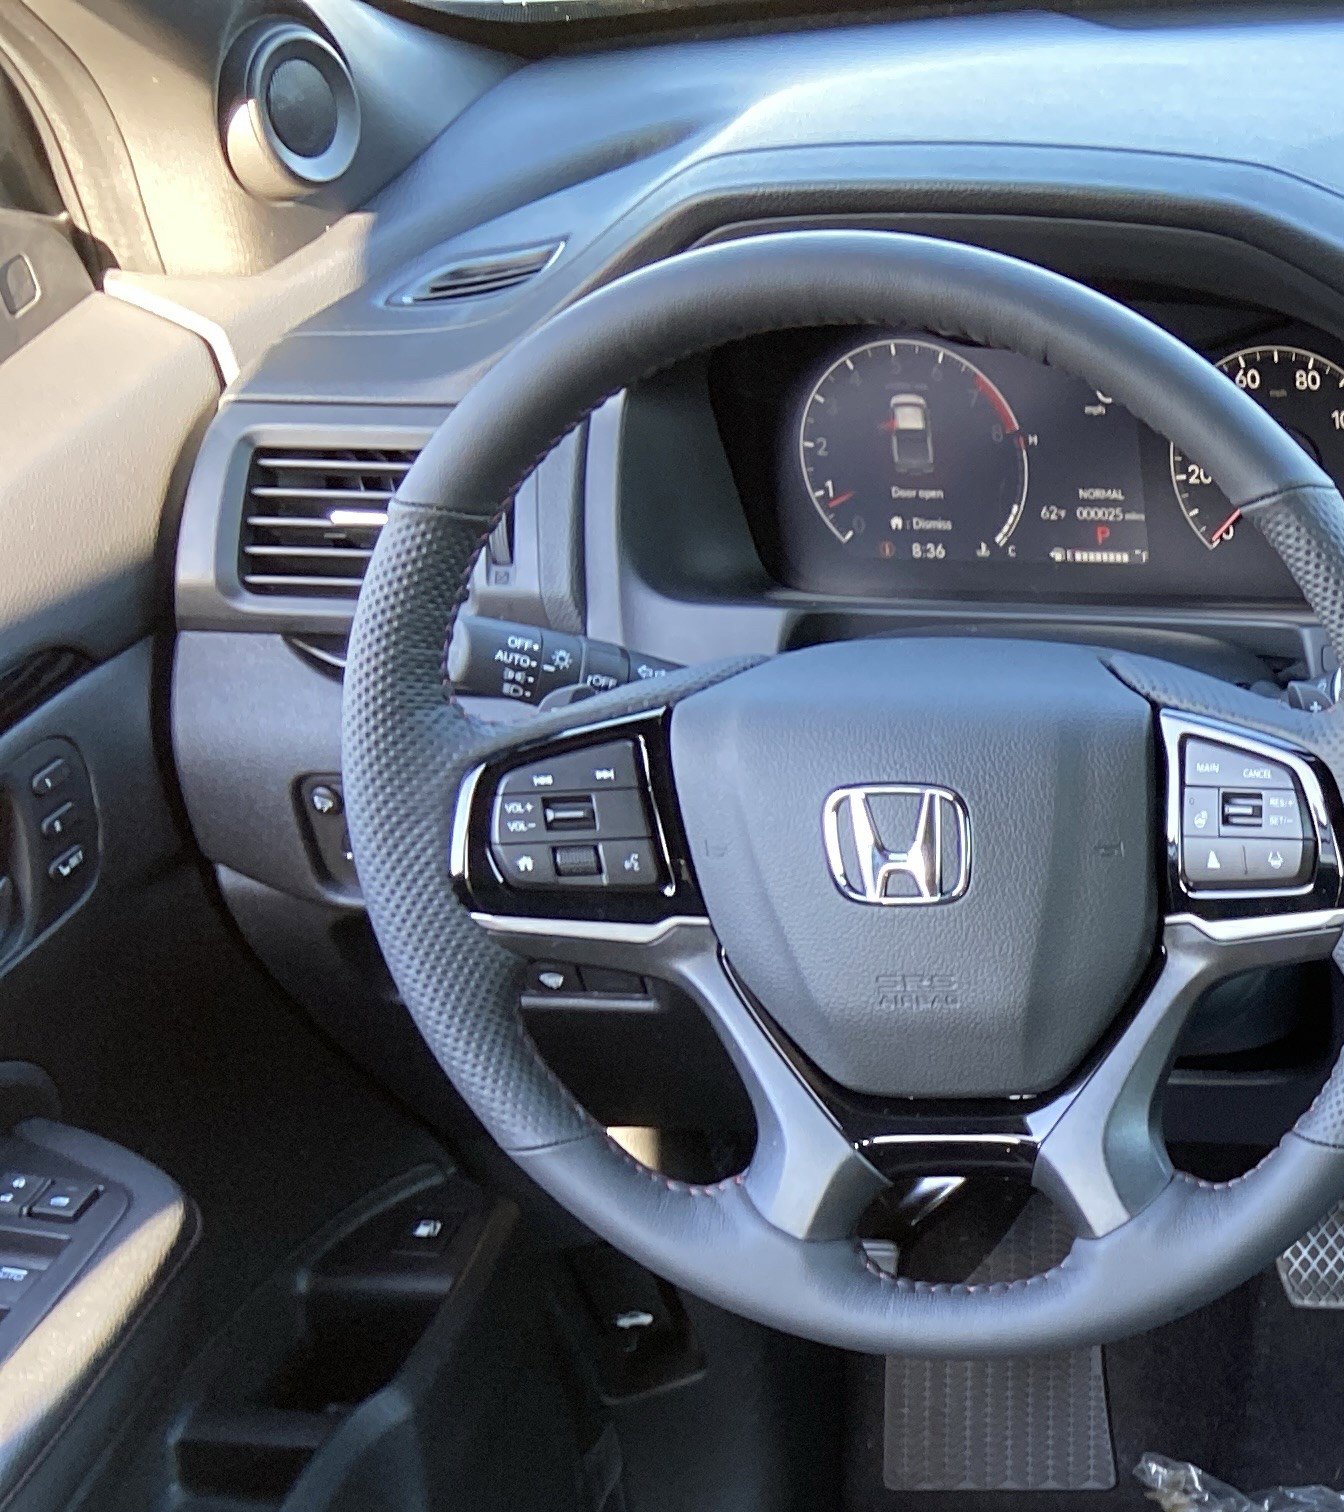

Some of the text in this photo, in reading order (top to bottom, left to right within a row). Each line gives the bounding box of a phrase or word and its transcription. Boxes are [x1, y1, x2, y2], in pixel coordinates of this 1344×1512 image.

[1235, 370, 1261, 390] 60
[1295, 370, 1321, 390] 80
[817, 437, 829, 456] 2
[824, 479, 834, 498] 1
[891, 486, 944, 500] Door open
[1079, 488, 1125, 500] NORMAL
[1076, 507, 1123, 521] 000025
[912, 517, 953, 531] Dismiss
[1096, 523, 1111, 545] P
[912, 543, 947, 559] 8:36
[508, 635, 533, 651] OFF
[495, 650, 531, 667] AUTO
[1196, 763, 1220, 774] MAIN
[1243, 768, 1272, 779] CANCEL
